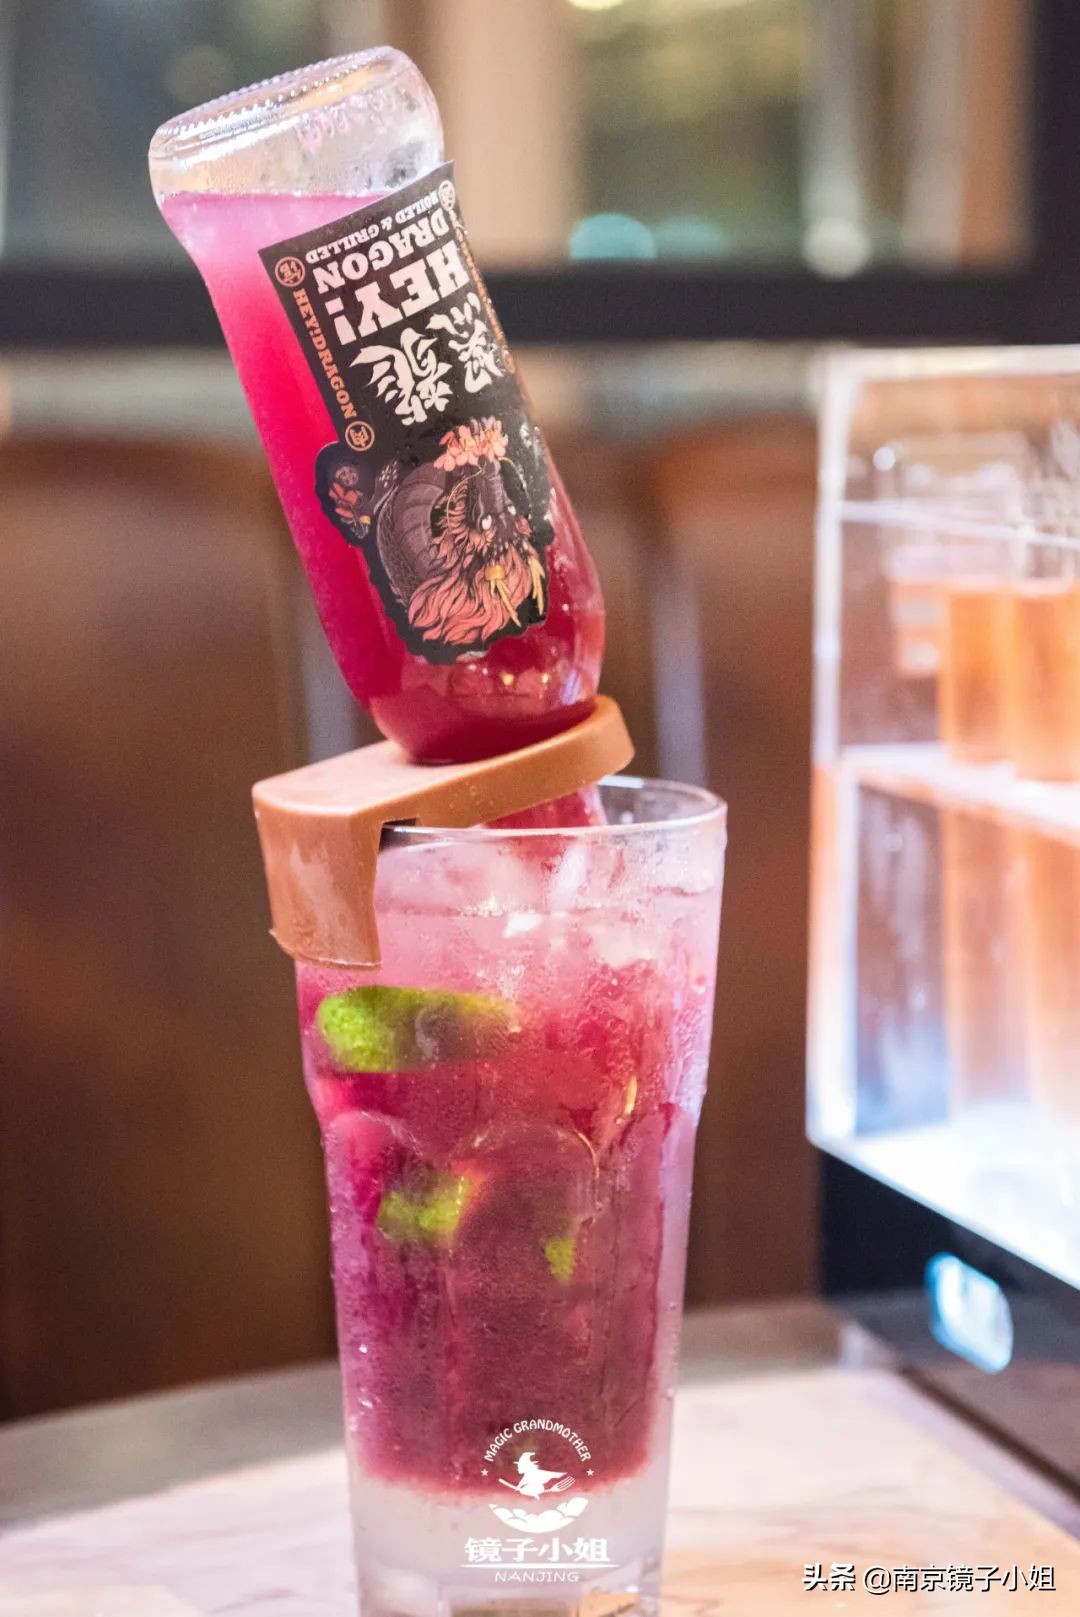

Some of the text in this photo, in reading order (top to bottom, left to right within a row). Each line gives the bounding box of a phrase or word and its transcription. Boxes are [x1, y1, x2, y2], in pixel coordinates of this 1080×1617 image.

[305, 225, 380, 264] GRILLED
[312, 208, 450, 294] DRAGON
[381, 216, 393, 231] &
[324, 240, 470, 346] HEY!
